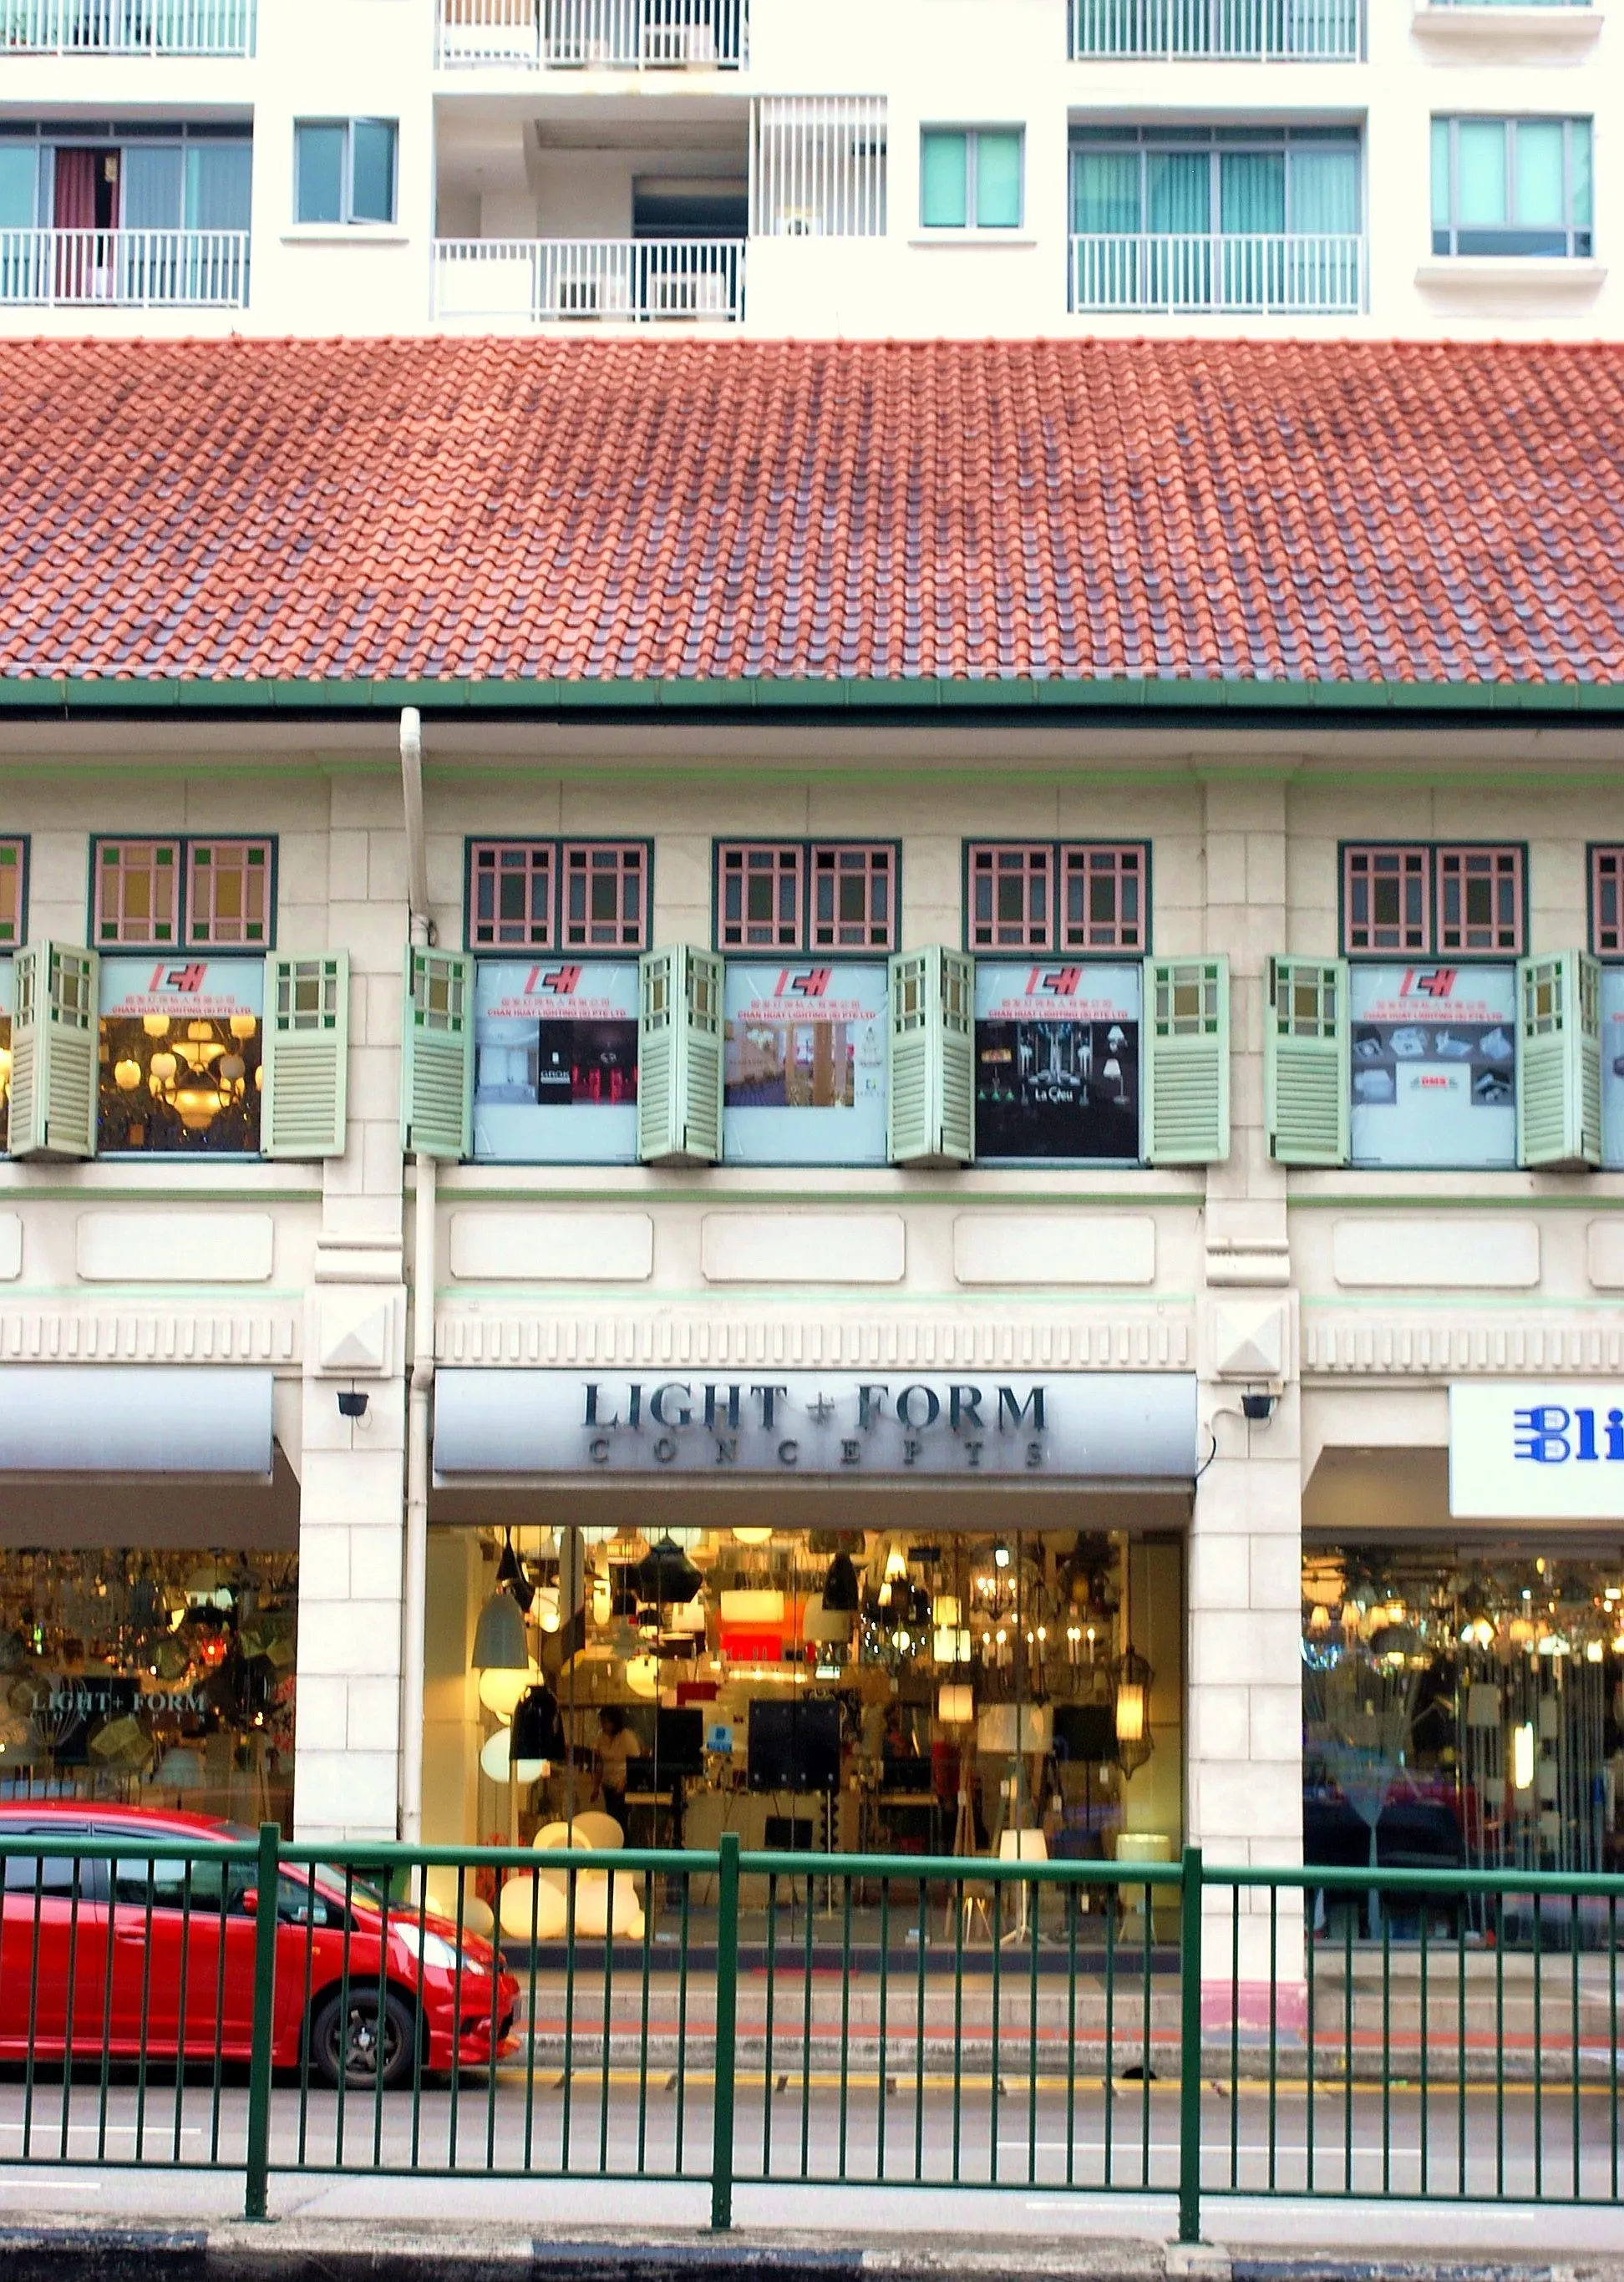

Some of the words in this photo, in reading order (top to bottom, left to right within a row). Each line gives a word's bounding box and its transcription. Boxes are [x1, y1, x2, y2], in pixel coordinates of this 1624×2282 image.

[112, 1006, 135, 1014] CHAN
[138, 1006, 160, 1014] HUAT
[162, 1006, 202, 1014] LIGHTING
[217, 1006, 233, 1014] PTE
[236, 1006, 251, 1014] LTD
[487, 1008, 510, 1017] CHAN
[538, 1008, 576, 1017] LIGHTING
[592, 1008, 608, 1017] PTE
[611, 1008, 627, 1017] LTD
[738, 1011, 761, 1019] CHAN
[789, 1011, 827, 1019] LIGHTING
[842, 1011, 858, 1019] PTE
[860, 1011, 876, 1019] LTD
[580, 1382, 787, 1428] LIGHT
[855, 1383, 1048, 1430] FORM
[588, 1438, 1043, 1467] CONCEPTS
[31, 1691, 111, 1712] LIGHT
[132, 1691, 206, 1712] FORM
